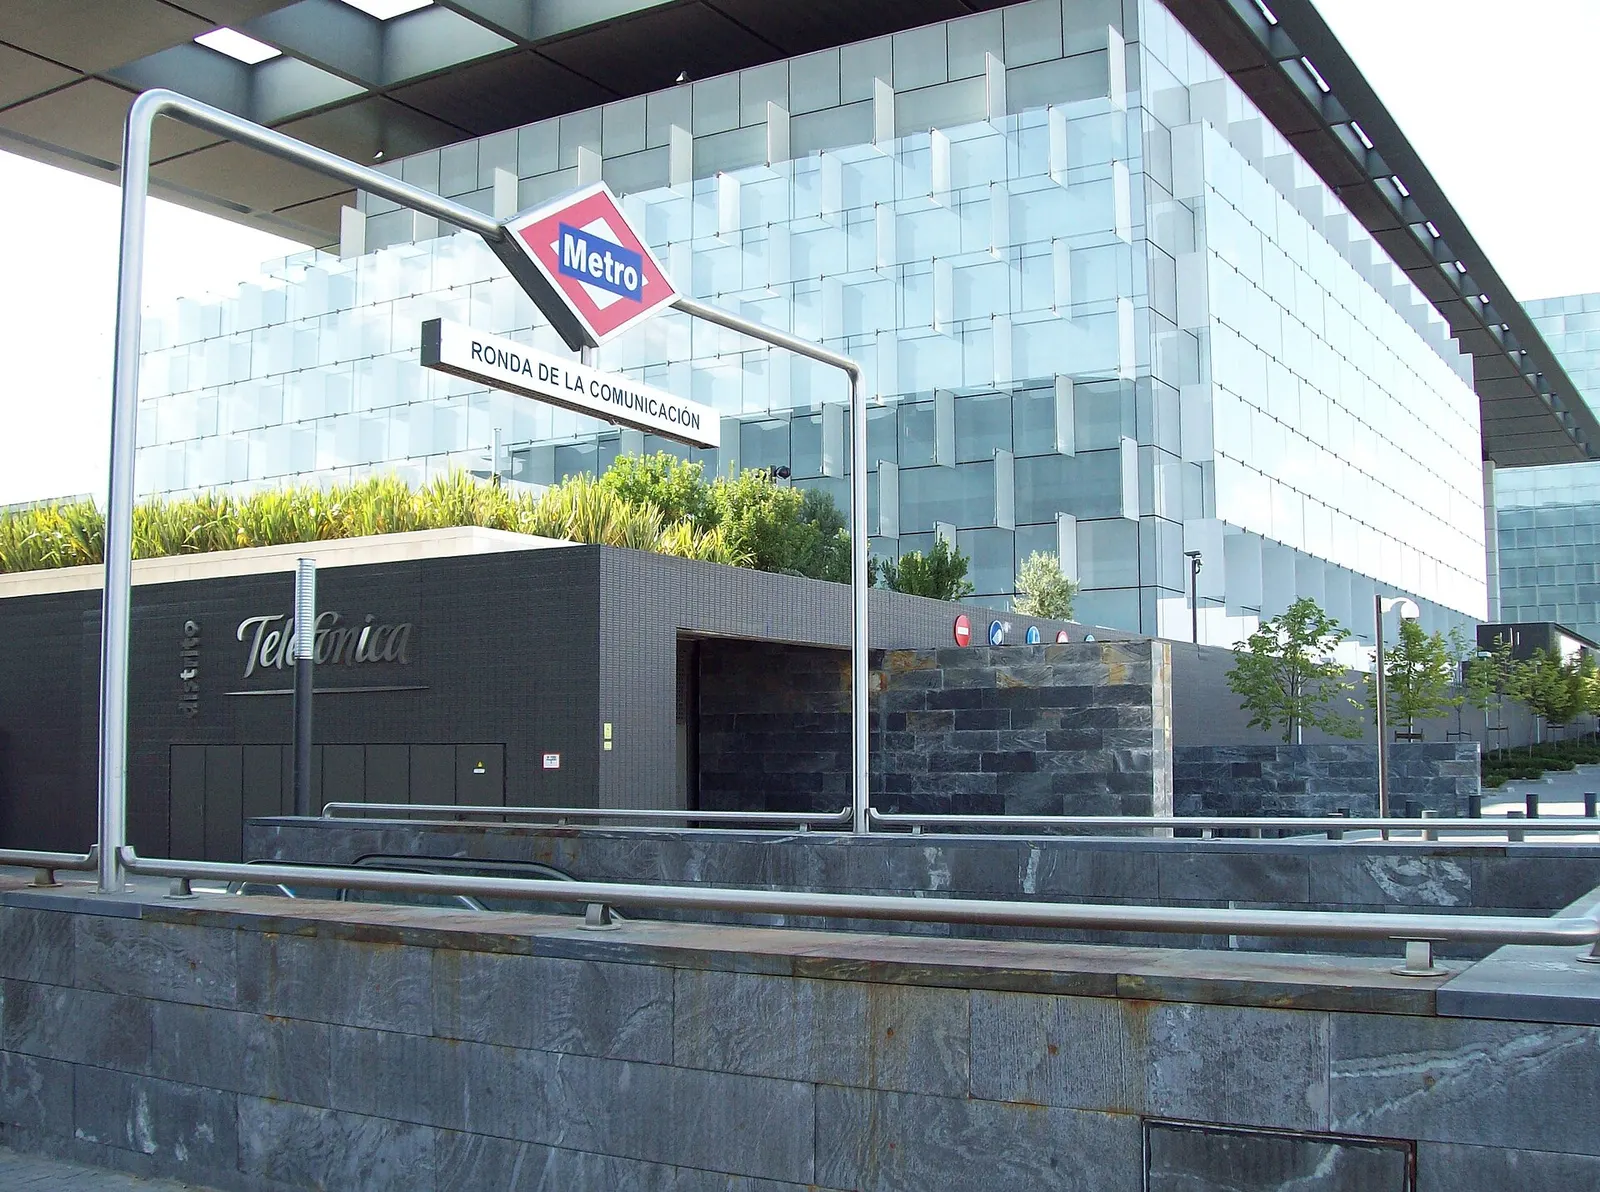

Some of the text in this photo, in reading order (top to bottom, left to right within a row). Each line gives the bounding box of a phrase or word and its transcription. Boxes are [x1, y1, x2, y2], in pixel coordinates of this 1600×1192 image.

[563, 234, 638, 291] Metro
[471, 341, 700, 430] RONDA DE LA COMUNICACIÓN
